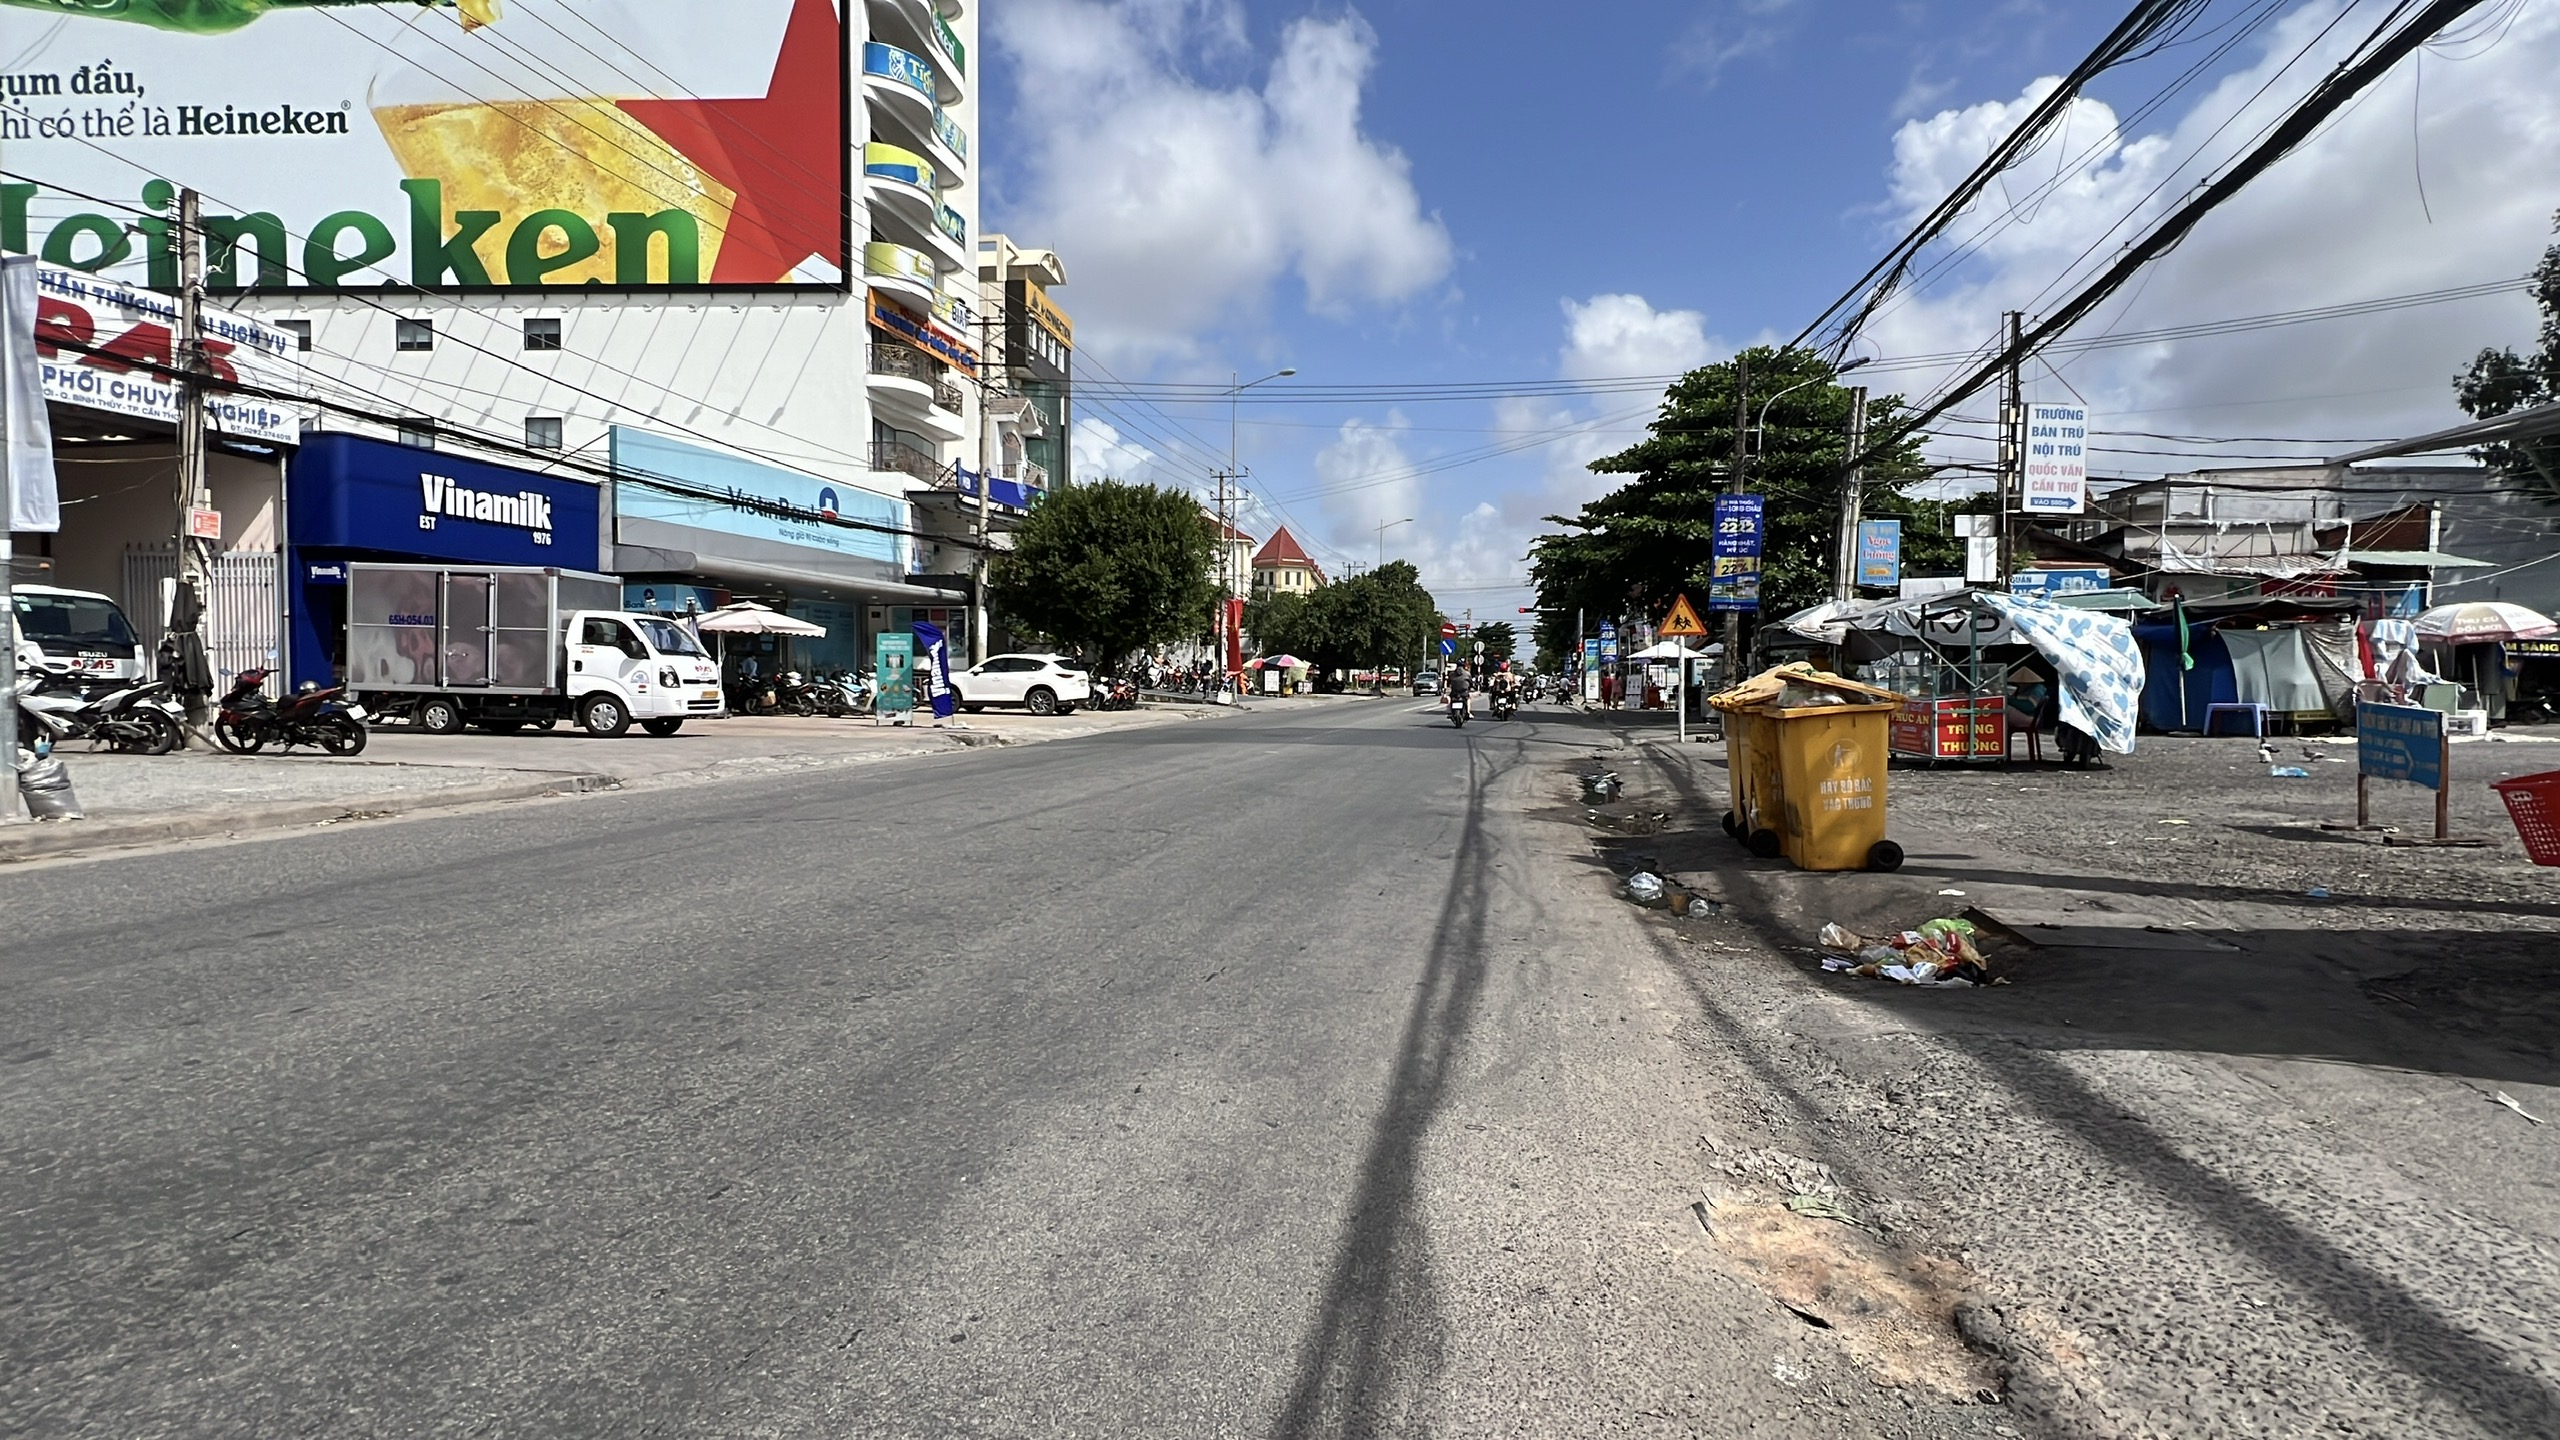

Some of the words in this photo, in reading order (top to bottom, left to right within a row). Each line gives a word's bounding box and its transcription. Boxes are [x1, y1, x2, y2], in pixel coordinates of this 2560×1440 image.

[70, 58, 145, 98] đầu,
[39, 107, 75, 138] có
[82, 101, 135, 137] thể
[143, 107, 171, 135] là
[42, 365, 101, 394] PHỐI
[110, 381, 183, 410] CHUY
[2035, 407, 2084, 420] TRƯỜNG
[2031, 424, 2057, 437] BÁN
[2061, 426, 2084, 438] TRÚ
[2033, 442, 2054, 457] NỘI
[2058, 443, 2082, 456] TRÚ
[421, 473, 552, 530] Vinamilk
[419, 514, 436, 530] EST
[533, 531, 552, 546] 1976
[1721, 563, 1748, 576] 22%
[78, 650, 108, 658] ISUZU
